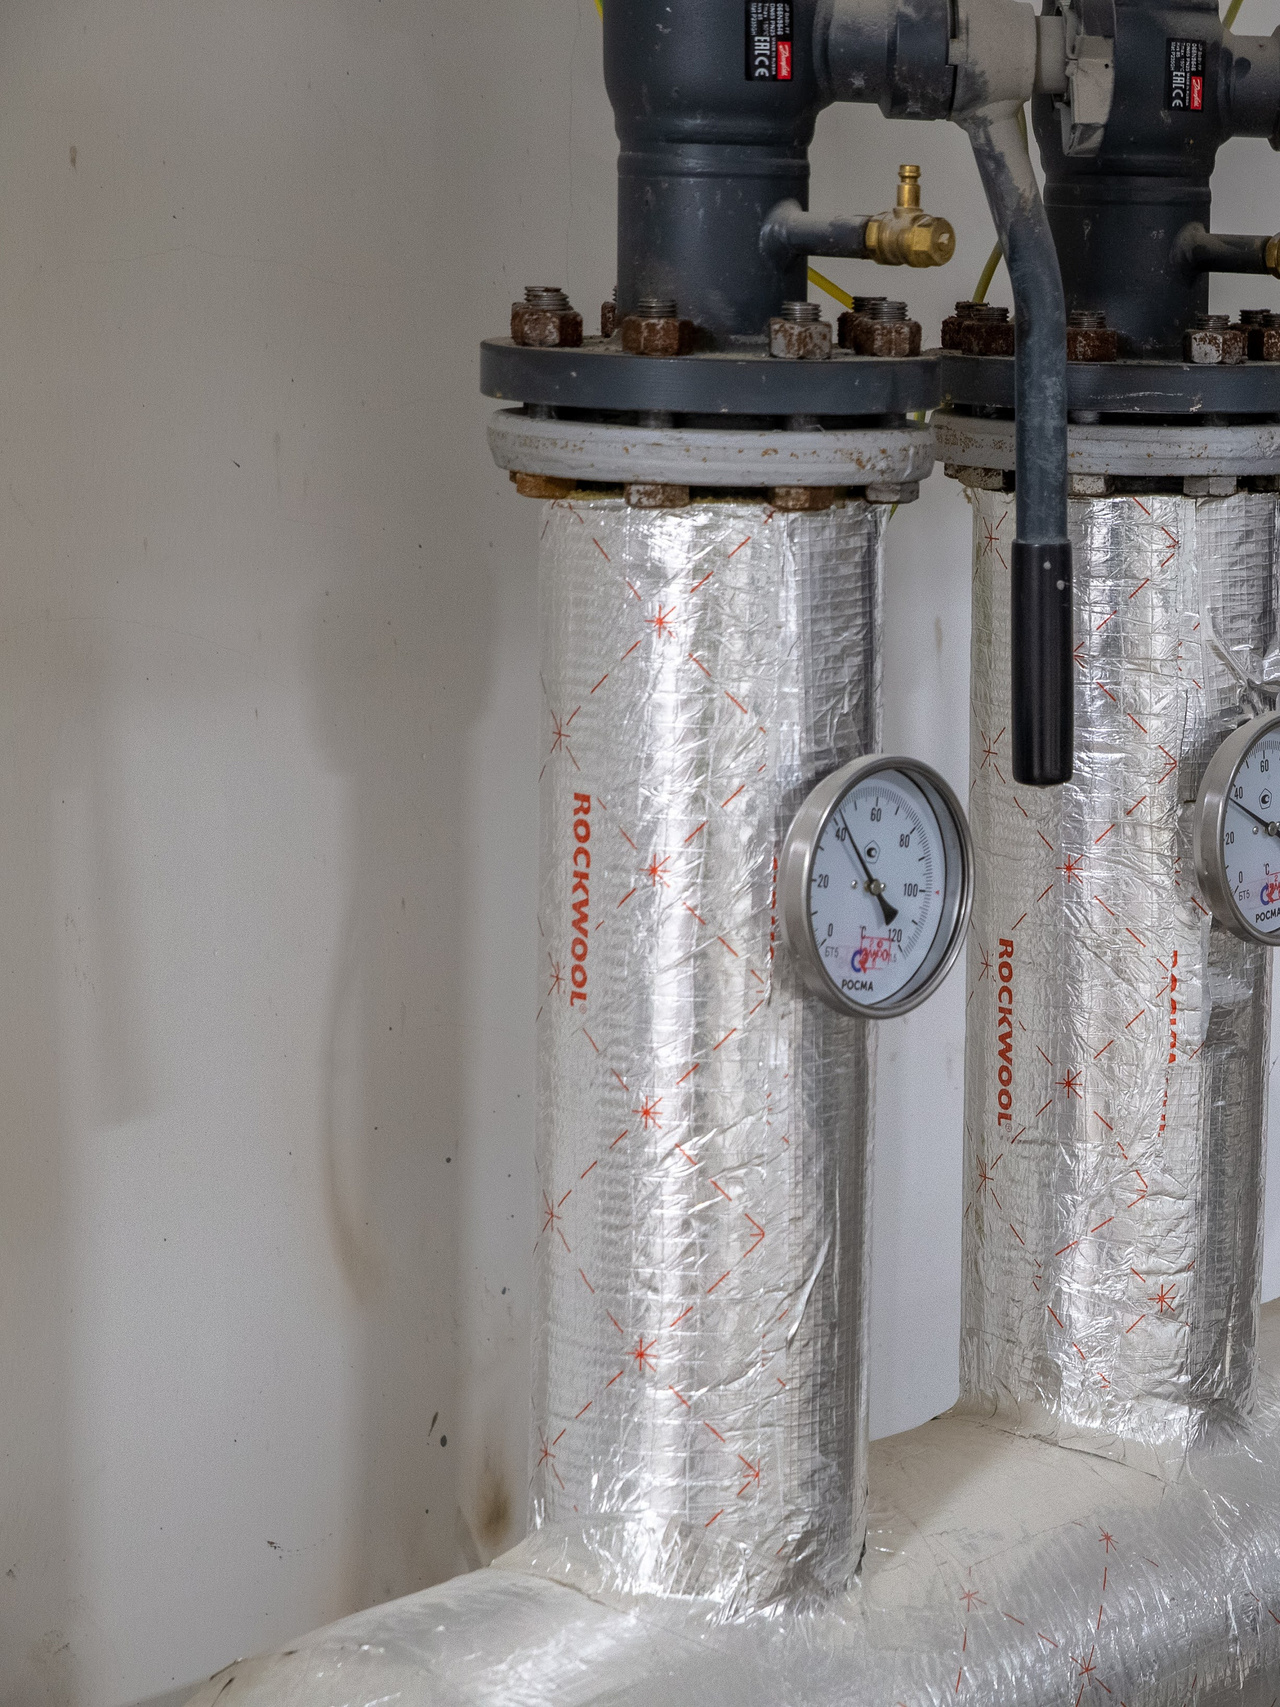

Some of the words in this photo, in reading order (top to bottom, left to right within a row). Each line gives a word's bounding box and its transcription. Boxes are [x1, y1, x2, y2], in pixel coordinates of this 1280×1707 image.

[1260, 759, 1269, 773] 60
[1234, 786, 1244, 799] 40
[870, 808, 882, 822] 60
[835, 827, 847, 841] 40
[899, 834, 910, 848] 80
[1225, 832, 1235, 846] 20
[817, 874, 829, 889] 20
[1238, 871, 1243, 884] 0
[903, 883, 918, 897] 100
[827, 924, 833, 937] 0
[888, 929, 903, 943] 120
[841, 979, 874, 991] РОСМА
